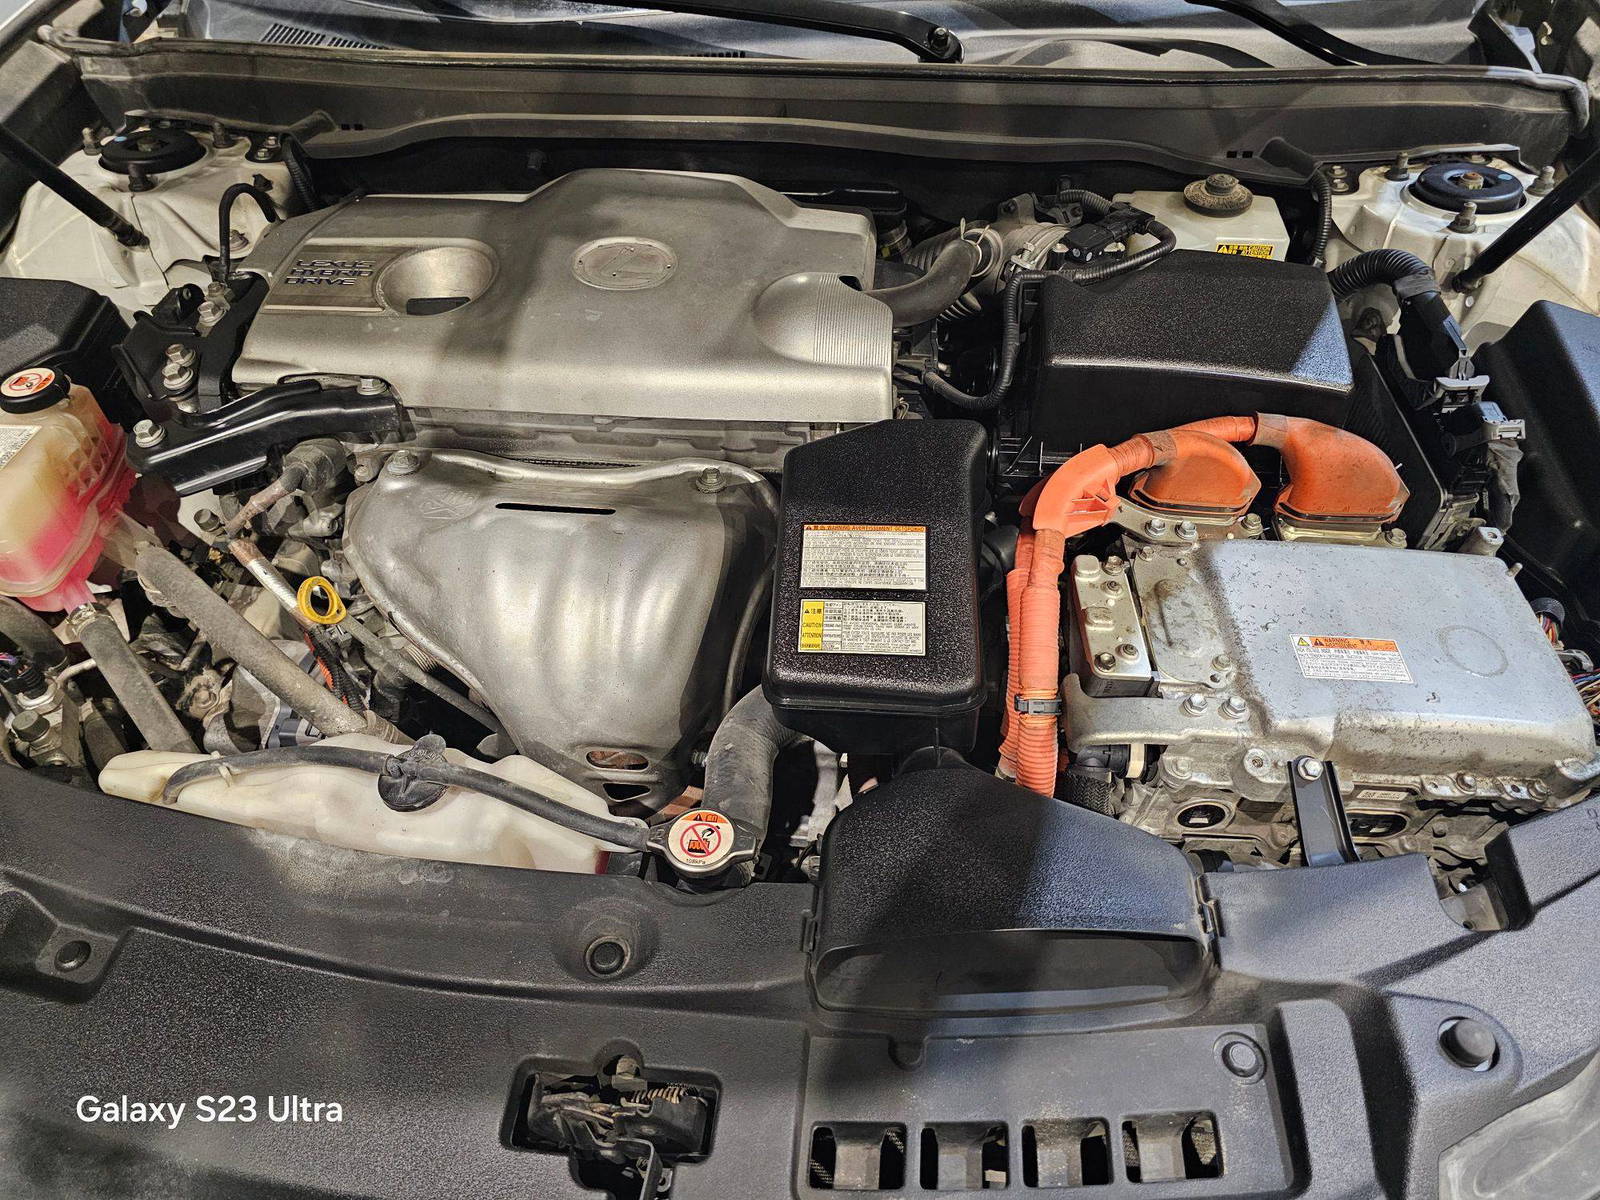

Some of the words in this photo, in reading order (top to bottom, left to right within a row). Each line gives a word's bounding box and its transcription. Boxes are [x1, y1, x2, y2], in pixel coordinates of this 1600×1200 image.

[297, 260, 376, 268] LEXUS
[290, 268, 374, 277] HYBRID
[285, 276, 357, 285] DRIVE
